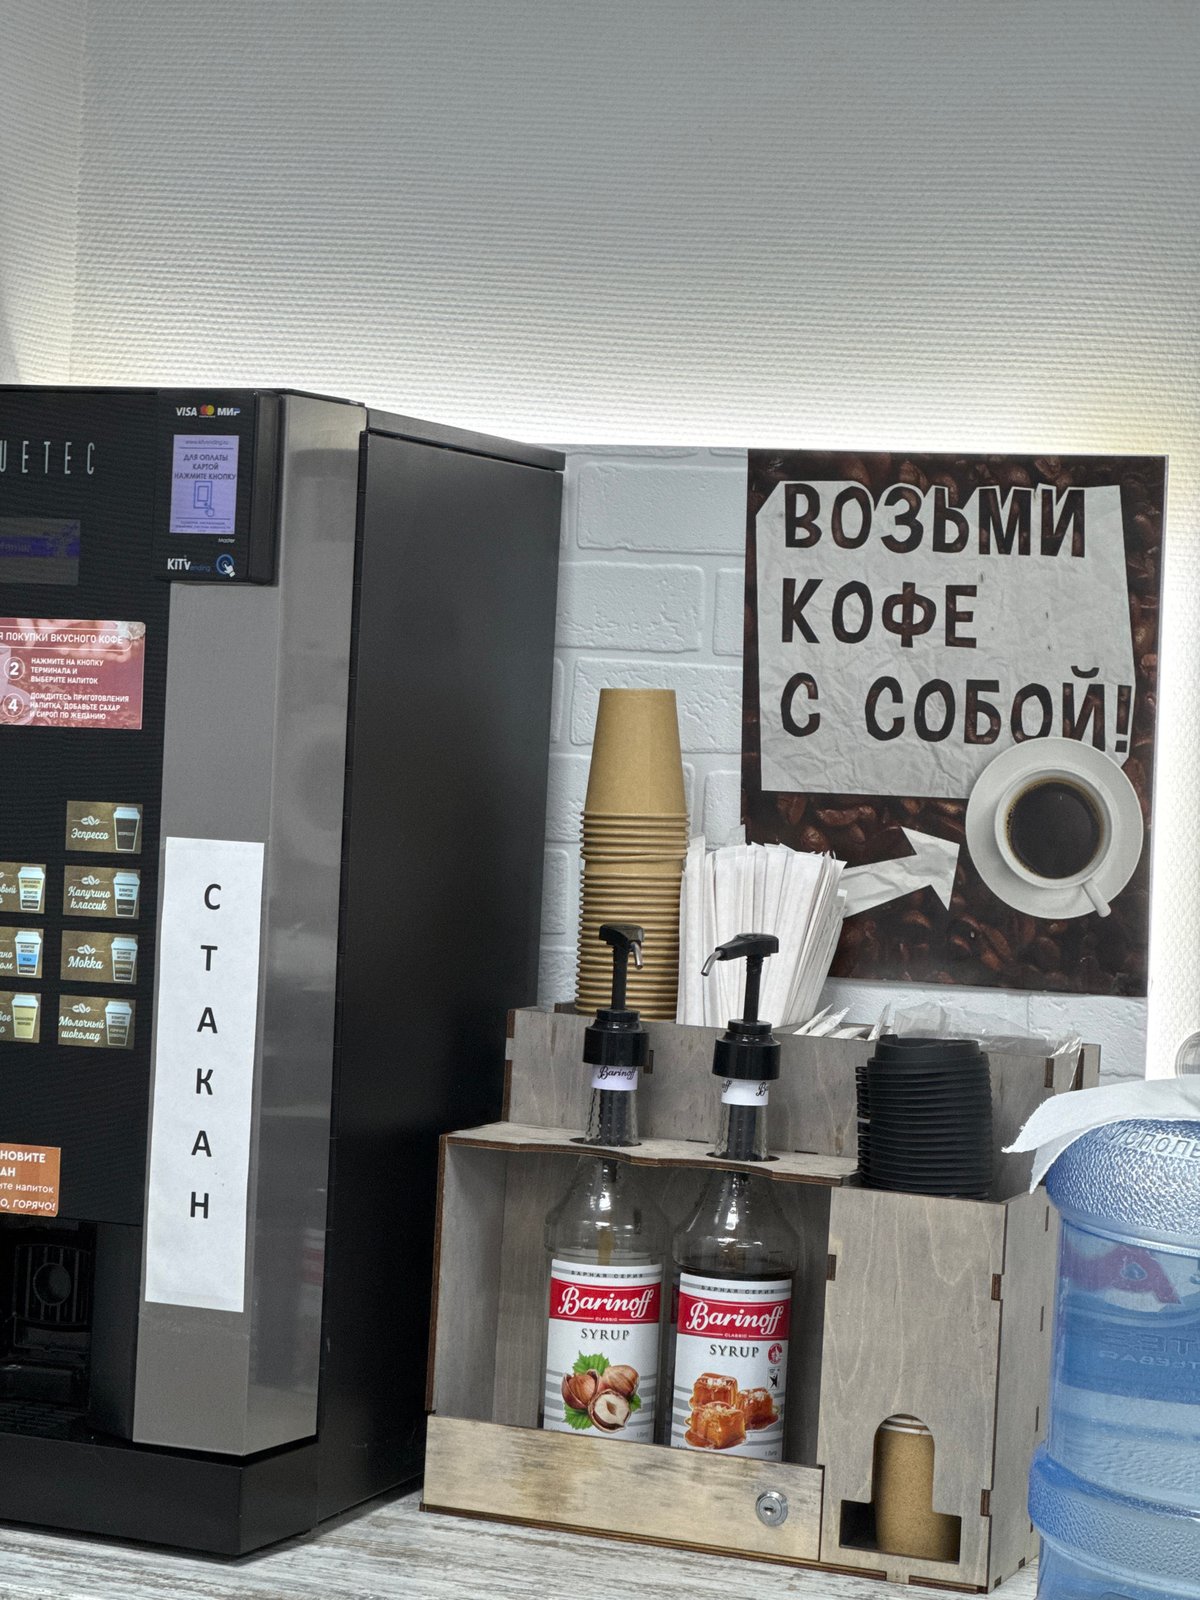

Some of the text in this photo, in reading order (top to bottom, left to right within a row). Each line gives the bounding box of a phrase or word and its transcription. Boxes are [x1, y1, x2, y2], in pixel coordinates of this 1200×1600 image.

[176, 407, 197, 416] VISA
[217, 407, 240, 416] МИР
[784, 484, 1085, 558] ВОЗЬМИ
[780, 578, 978, 648] КОФЕ
[6, 632, 48, 642] ПОКУПКИ
[51, 633, 96, 644] ВКУСНОГО
[99, 635, 124, 644] КОФЕ
[10, 662, 19, 676] 2
[30, 693, 129, 702] ДОЖДИТЕСЬ ПРИГОТОВЛЕНИЯ
[8, 699, 18, 712] 4
[64, 703, 98, 711] ДОБАВЬТЕ
[780, 666, 1132, 752] С СОБОЙ!
[71, 828, 109, 840] Эспрессо
[68, 886, 111, 898] Капучино
[70, 898, 107, 911] классик
[68, 956, 103, 969] Мокка
[59, 1016, 104, 1029] Молочный
[61, 1029, 101, 1042] шоколад
[189, 884, 222, 1219] СТАКАН
[597, 1065, 636, 1080] Barinoff
[0, 1150, 46, 1163] НОВИТЕ
[16, 1184, 54, 1193] напиток
[12, 1199, 56, 1211] ГОРЯЧО!
[558, 1286, 654, 1318] Barinoff
[686, 1301, 784, 1335] Barinoff
[581, 1328, 630, 1340] SYRUP
[709, 1344, 760, 1358] SYRUP
